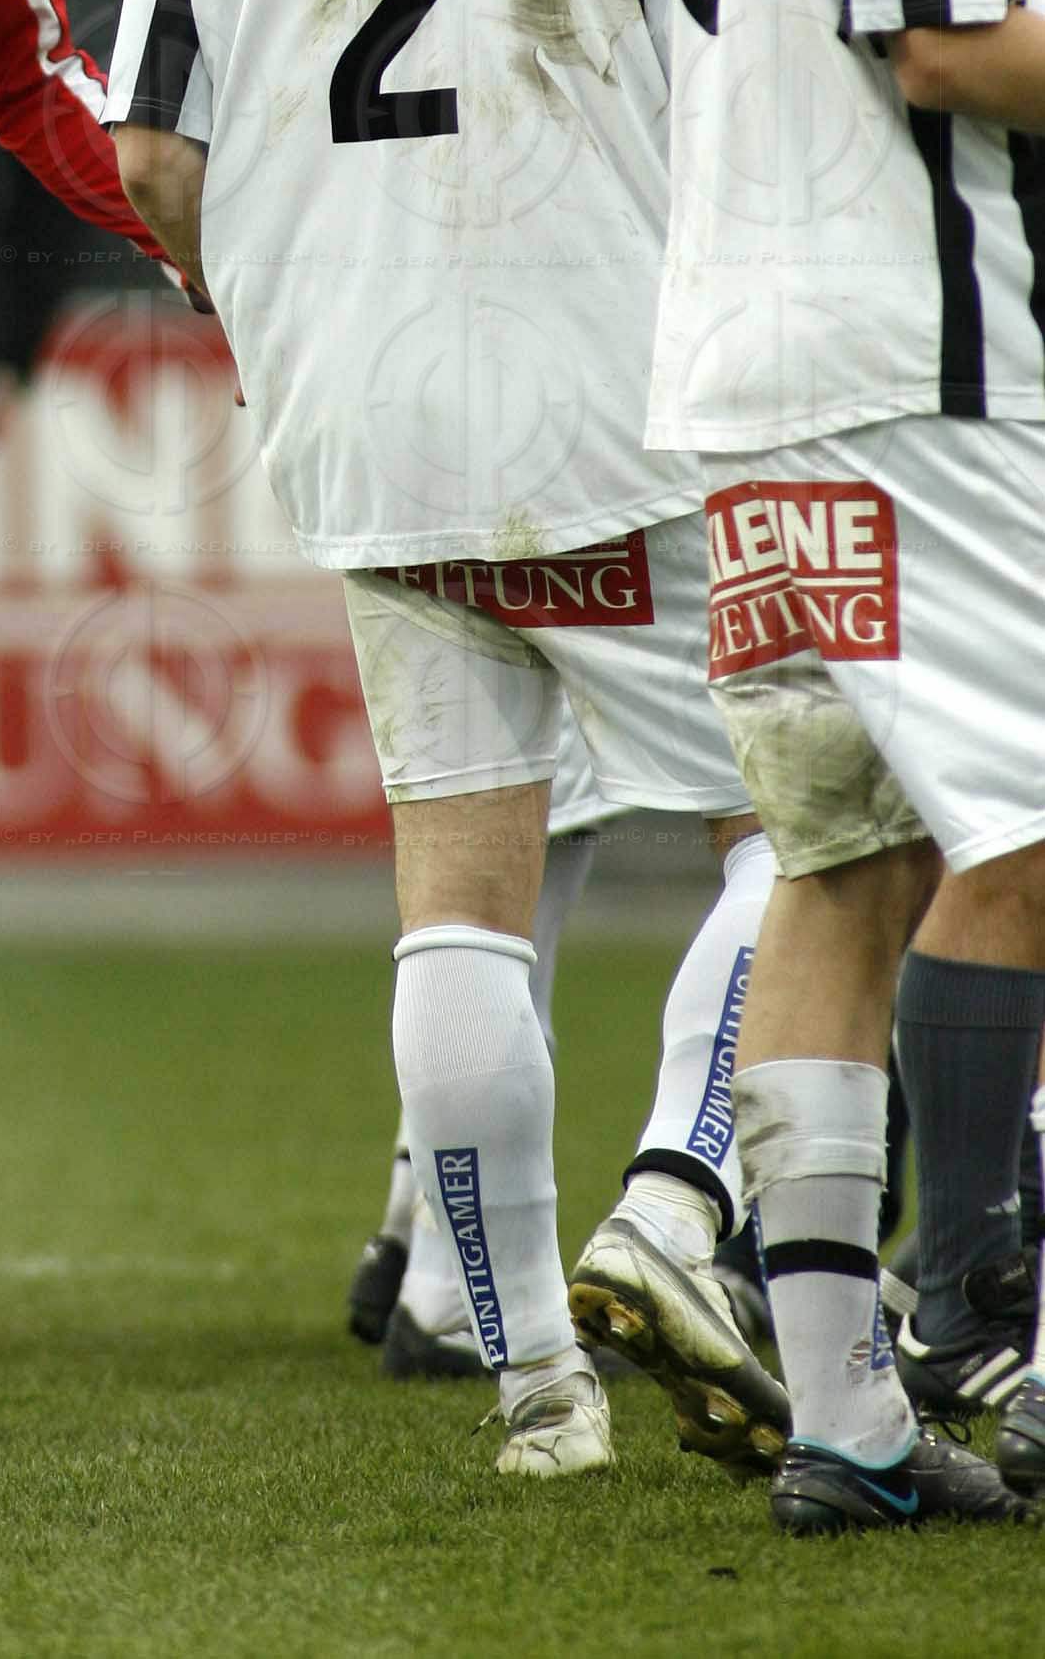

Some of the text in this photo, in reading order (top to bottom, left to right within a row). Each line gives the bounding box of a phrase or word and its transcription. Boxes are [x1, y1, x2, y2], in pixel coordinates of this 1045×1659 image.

[398, 560, 638, 611] EITUNG
[709, 591, 888, 663] ZEITNG
[440, 1153, 506, 1365] PUNTIGAMER
